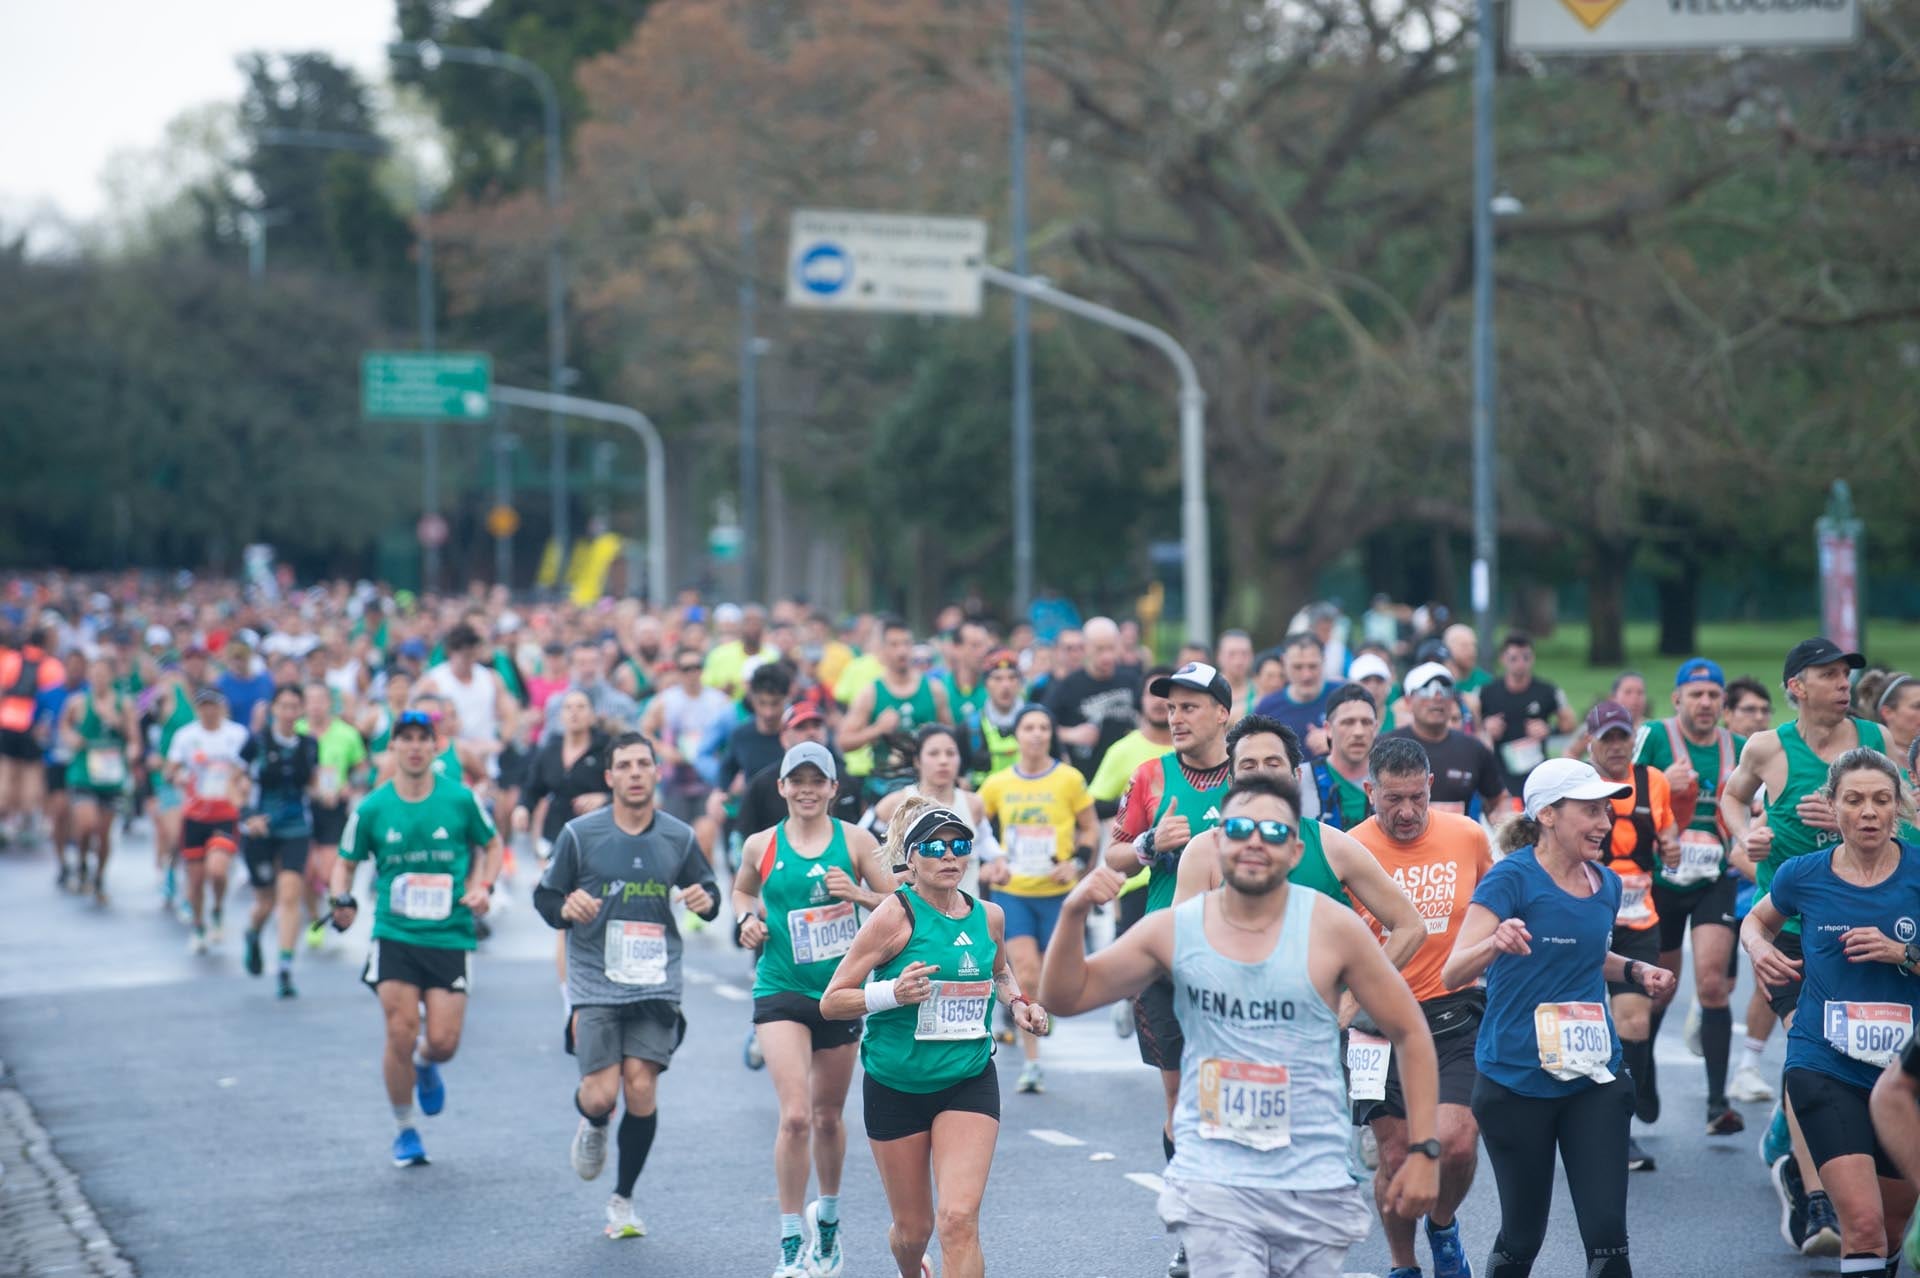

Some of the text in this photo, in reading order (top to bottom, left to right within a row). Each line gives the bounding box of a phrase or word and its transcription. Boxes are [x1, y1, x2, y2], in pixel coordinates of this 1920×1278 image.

[1392, 860, 1458, 890] ASICS
[1419, 900, 1453, 918] 2023
[812, 918, 856, 948] 10049
[939, 998, 985, 1023] 16593
[1831, 1009, 1843, 1034] F
[1563, 1025, 1609, 1053] 13061
[1856, 1024, 1905, 1054] 9602
